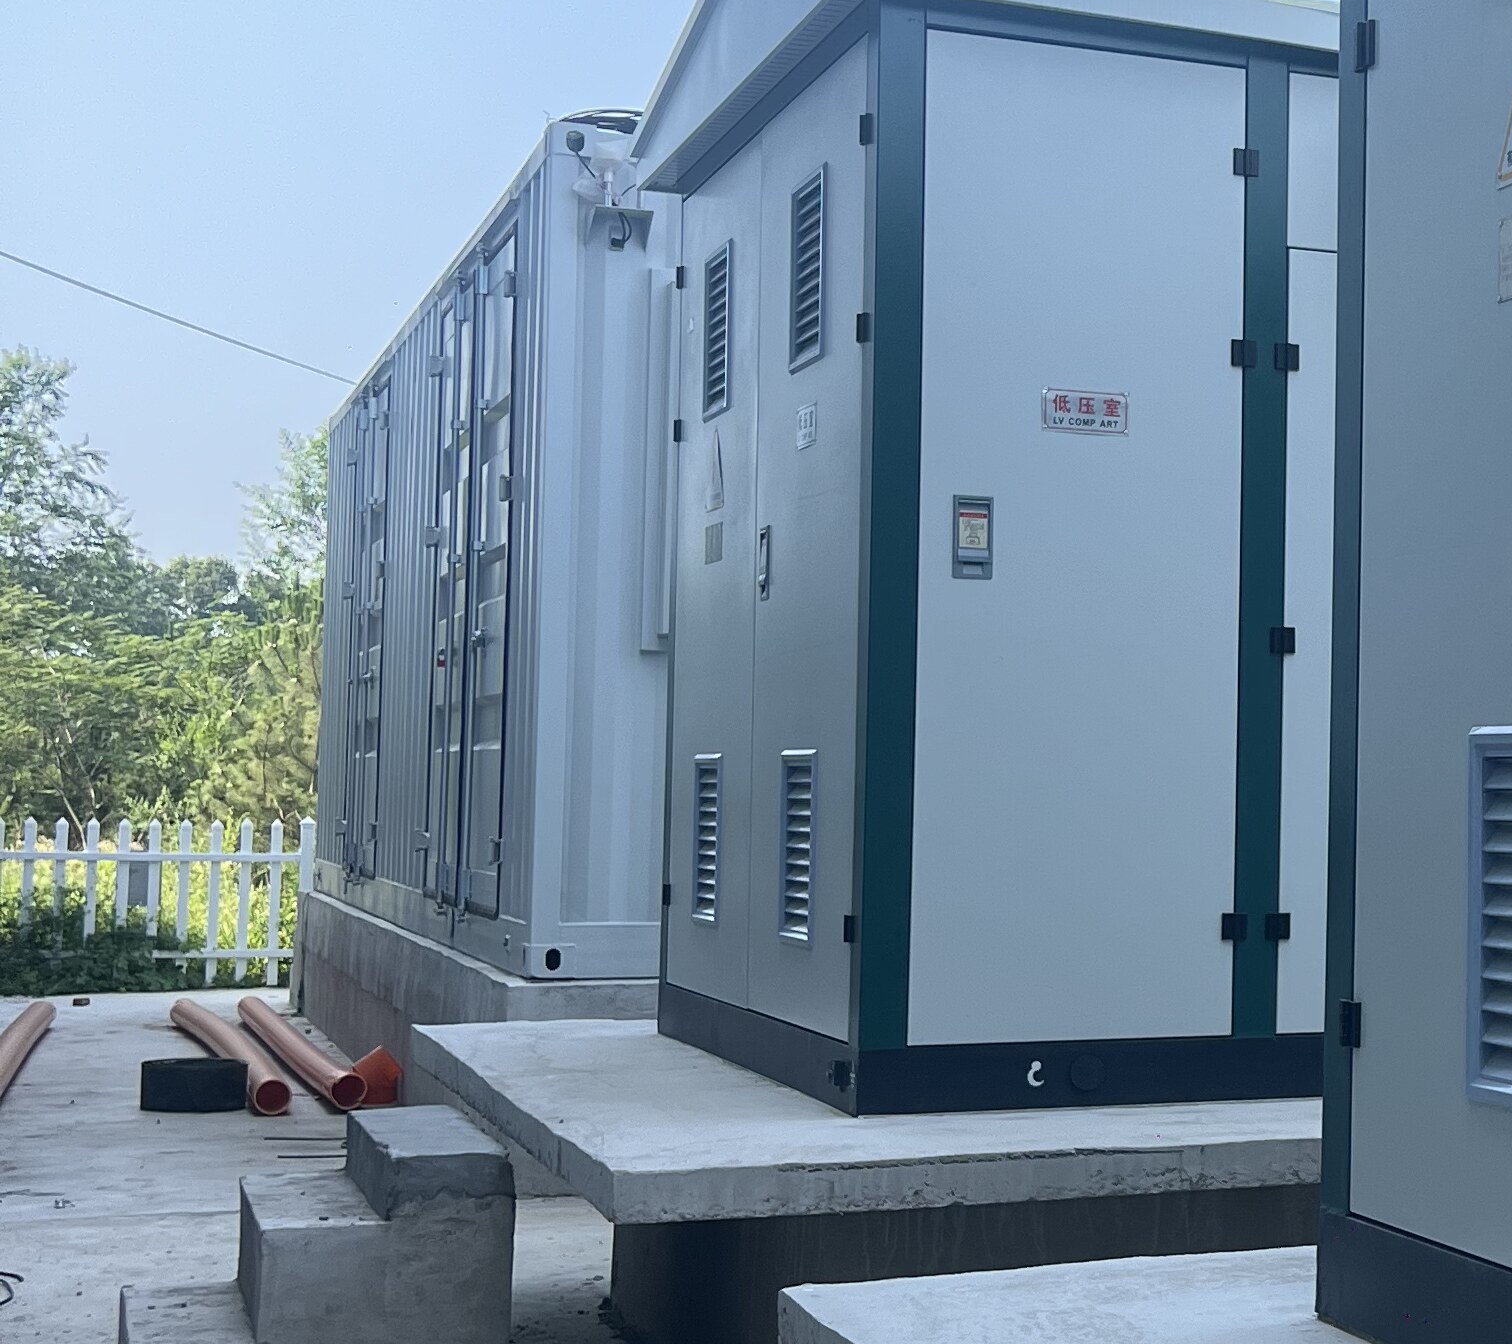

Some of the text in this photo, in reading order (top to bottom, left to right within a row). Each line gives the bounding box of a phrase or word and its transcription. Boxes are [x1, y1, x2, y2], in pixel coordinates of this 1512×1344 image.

[1052, 393, 1121, 418] 低压室
[1053, 416, 1119, 429] LV COMP ART
